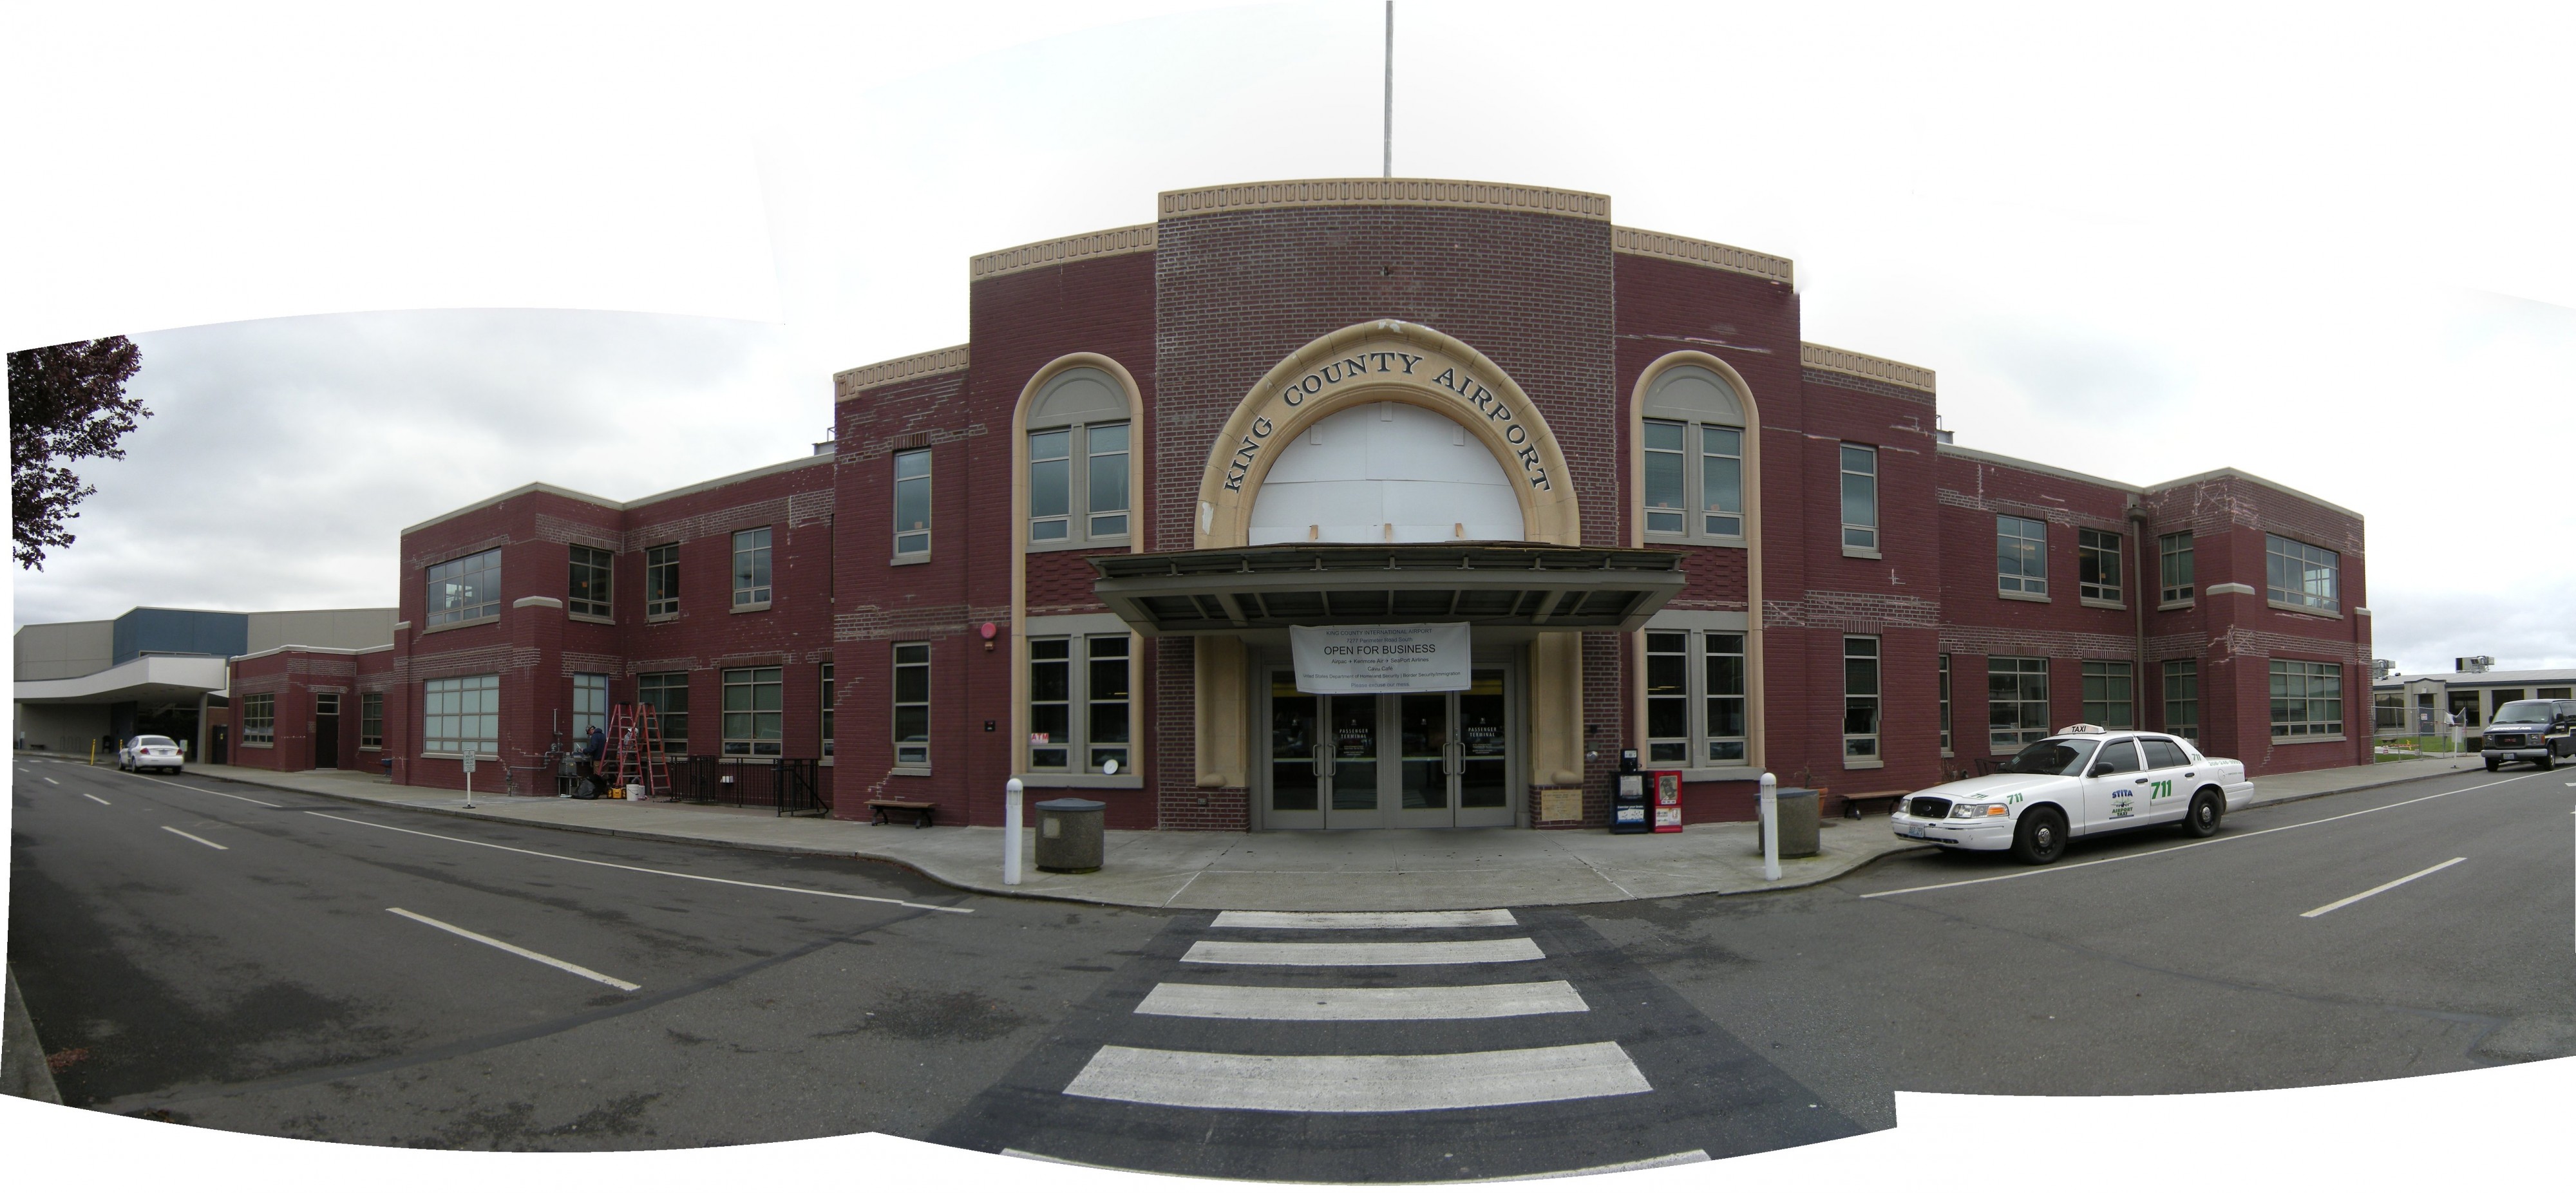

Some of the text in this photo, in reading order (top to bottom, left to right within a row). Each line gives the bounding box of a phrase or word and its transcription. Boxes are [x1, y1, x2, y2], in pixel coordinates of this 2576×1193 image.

[1224, 351, 1551, 494] KING COUNTY AIRPORT
[1324, 644, 1435, 655] OPEN FOR BUSINESS
[2112, 789, 2133, 798] STITA
[2151, 780, 2172, 800] 711
[2007, 793, 2023, 805] 711
